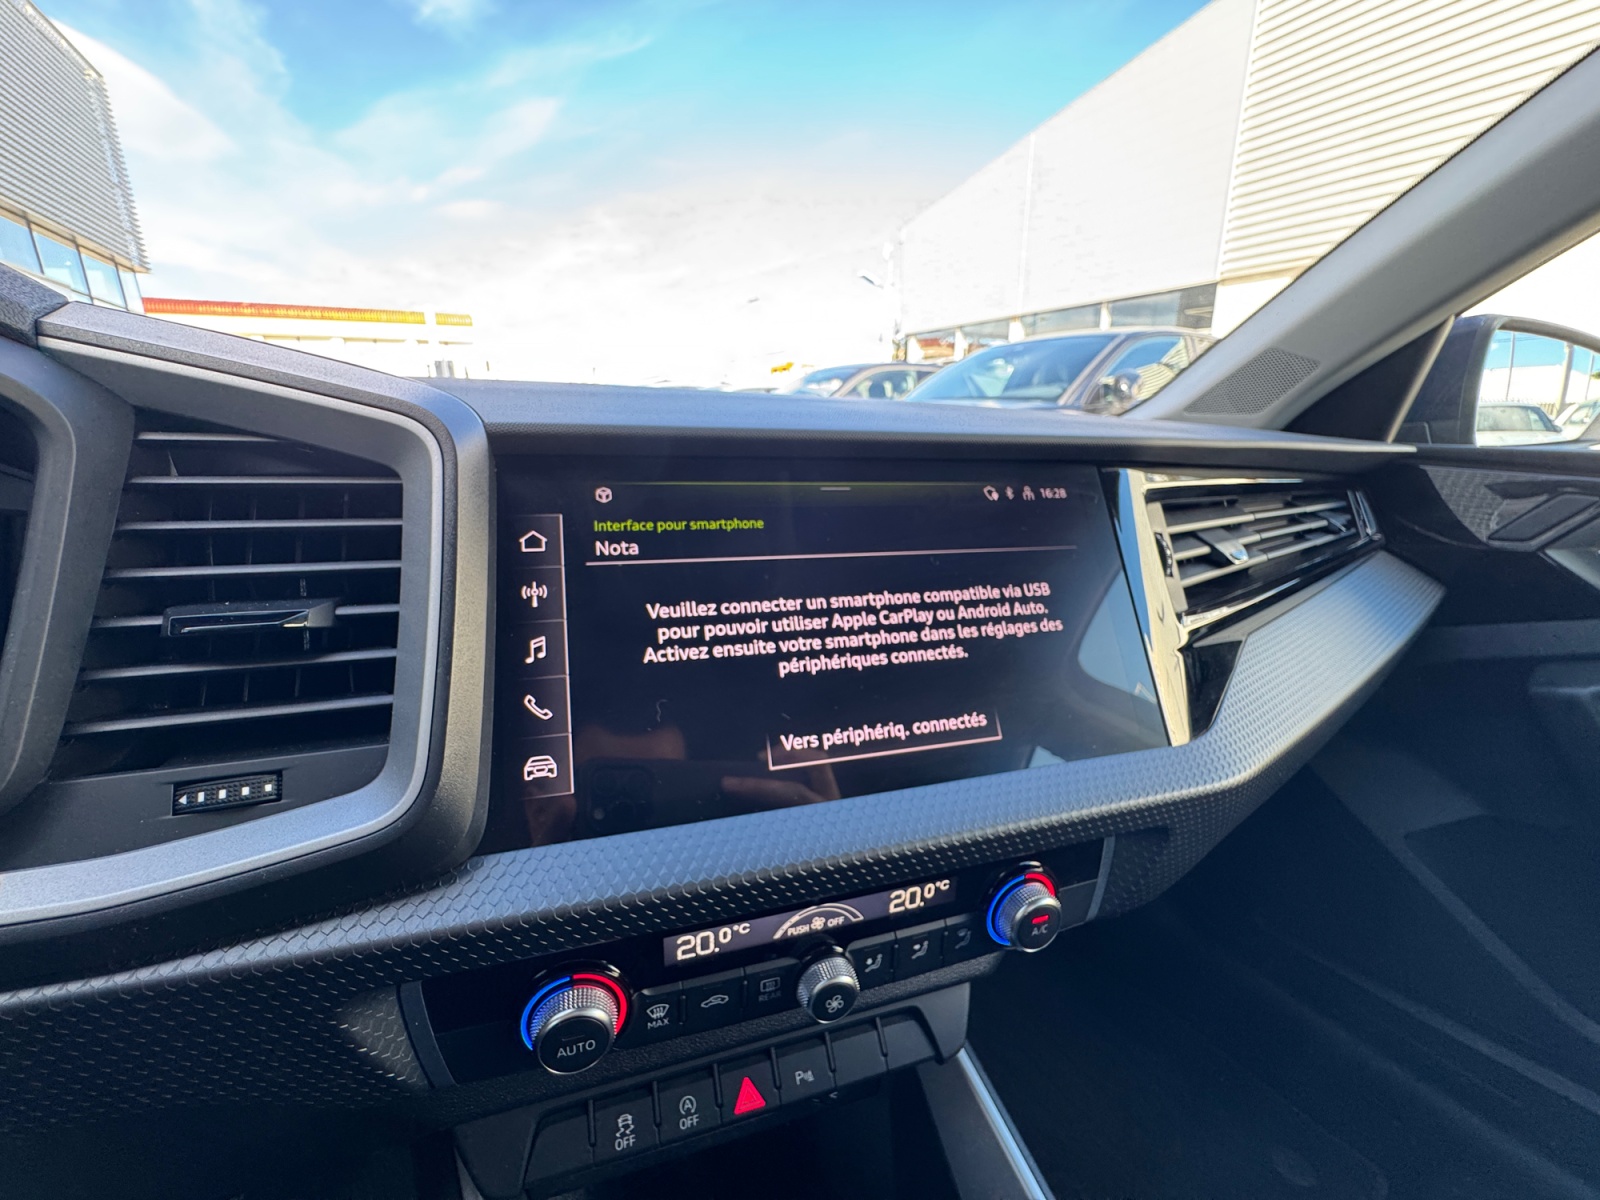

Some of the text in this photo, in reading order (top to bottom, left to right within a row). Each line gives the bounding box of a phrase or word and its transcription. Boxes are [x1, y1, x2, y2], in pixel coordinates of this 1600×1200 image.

[594, 517, 764, 533] Interface pour smartphone
[595, 540, 640, 556] Nota
[646, 582, 1051, 619] Veuillez connecter un smartphone compatible via USB
[657, 601, 1049, 644] pour pouvoir utiliser Apple CarPlay ou Android Auto.
[643, 617, 1064, 664] Activez ensuite votre smartphone dans les réglages des
[778, 643, 969, 678] périphériques connectés.
[780, 711, 987, 751] Vers périphériq. connectés
[787, 915, 845, 936] PUSH OFF
[1031, 923, 1049, 936] A/C
[758, 991, 782, 1003] REAR
[647, 1017, 670, 1030] MAX
[556, 1039, 597, 1058] AUTO
[679, 1114, 700, 1130] OFF
[614, 1134, 636, 1151] OFF
